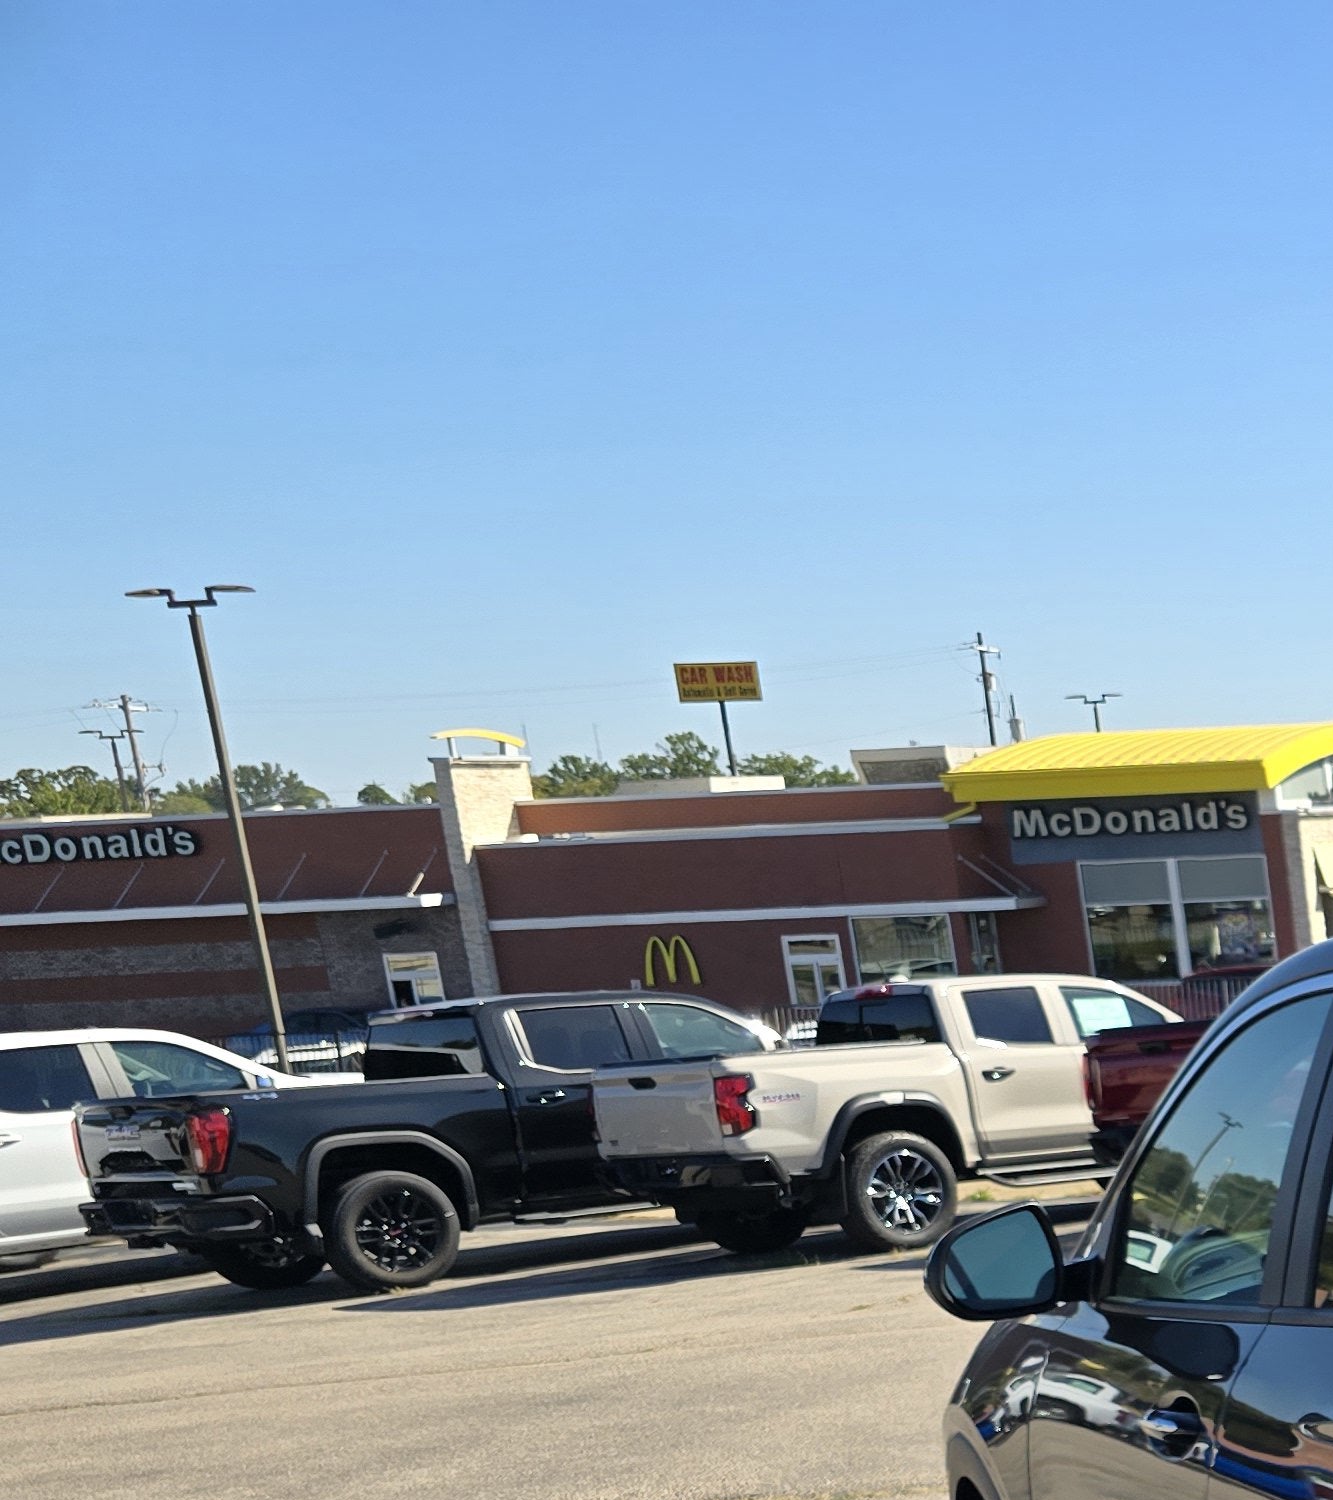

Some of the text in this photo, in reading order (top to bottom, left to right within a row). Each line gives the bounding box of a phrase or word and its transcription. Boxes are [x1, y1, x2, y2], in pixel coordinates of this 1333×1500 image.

[680, 664, 754, 684] CAR WASH
[1013, 801, 1248, 839] McDonald's
[0, 827, 196, 865] cDonald's
